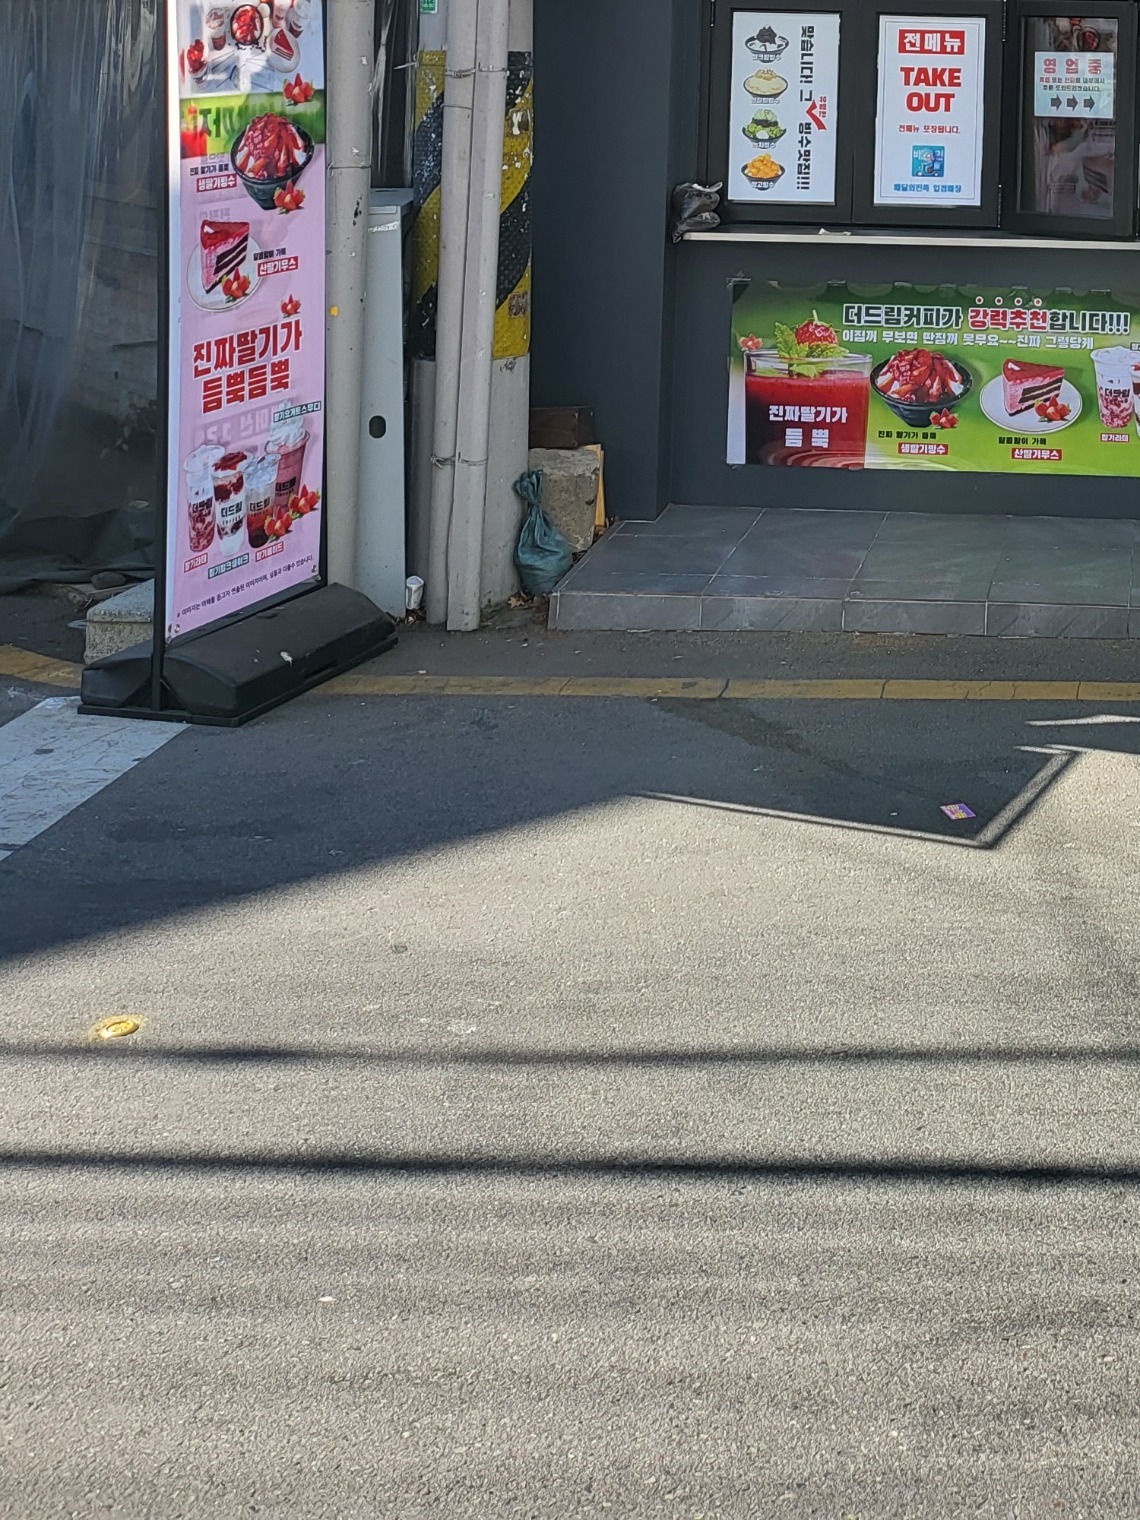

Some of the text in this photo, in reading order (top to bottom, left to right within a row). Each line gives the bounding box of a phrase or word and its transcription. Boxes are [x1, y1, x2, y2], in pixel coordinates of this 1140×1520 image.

[903, 32, 962, 53] 전메뉴
[899, 66, 962, 87] TAKE
[796, 25, 815, 191] 맞습니다! 그 빙수맛집!!!
[905, 92, 956, 113] OUT
[843, 303, 1131, 335] 더드림커피가 강력추천합니다!!!
[193, 319, 303, 379] 진짜딸기가
[842, 331, 877, 344] 이집꺼
[923, 332, 959, 346] 딴집꺼
[201, 358, 290, 415] 듬뿍듬뿍
[768, 404, 848, 424] 진짜딸기가
[900, 443, 947, 455] 생딸기빙수
[1013, 448, 1061, 461] 산딸기무스
[220, 500, 243, 518] 더드림
